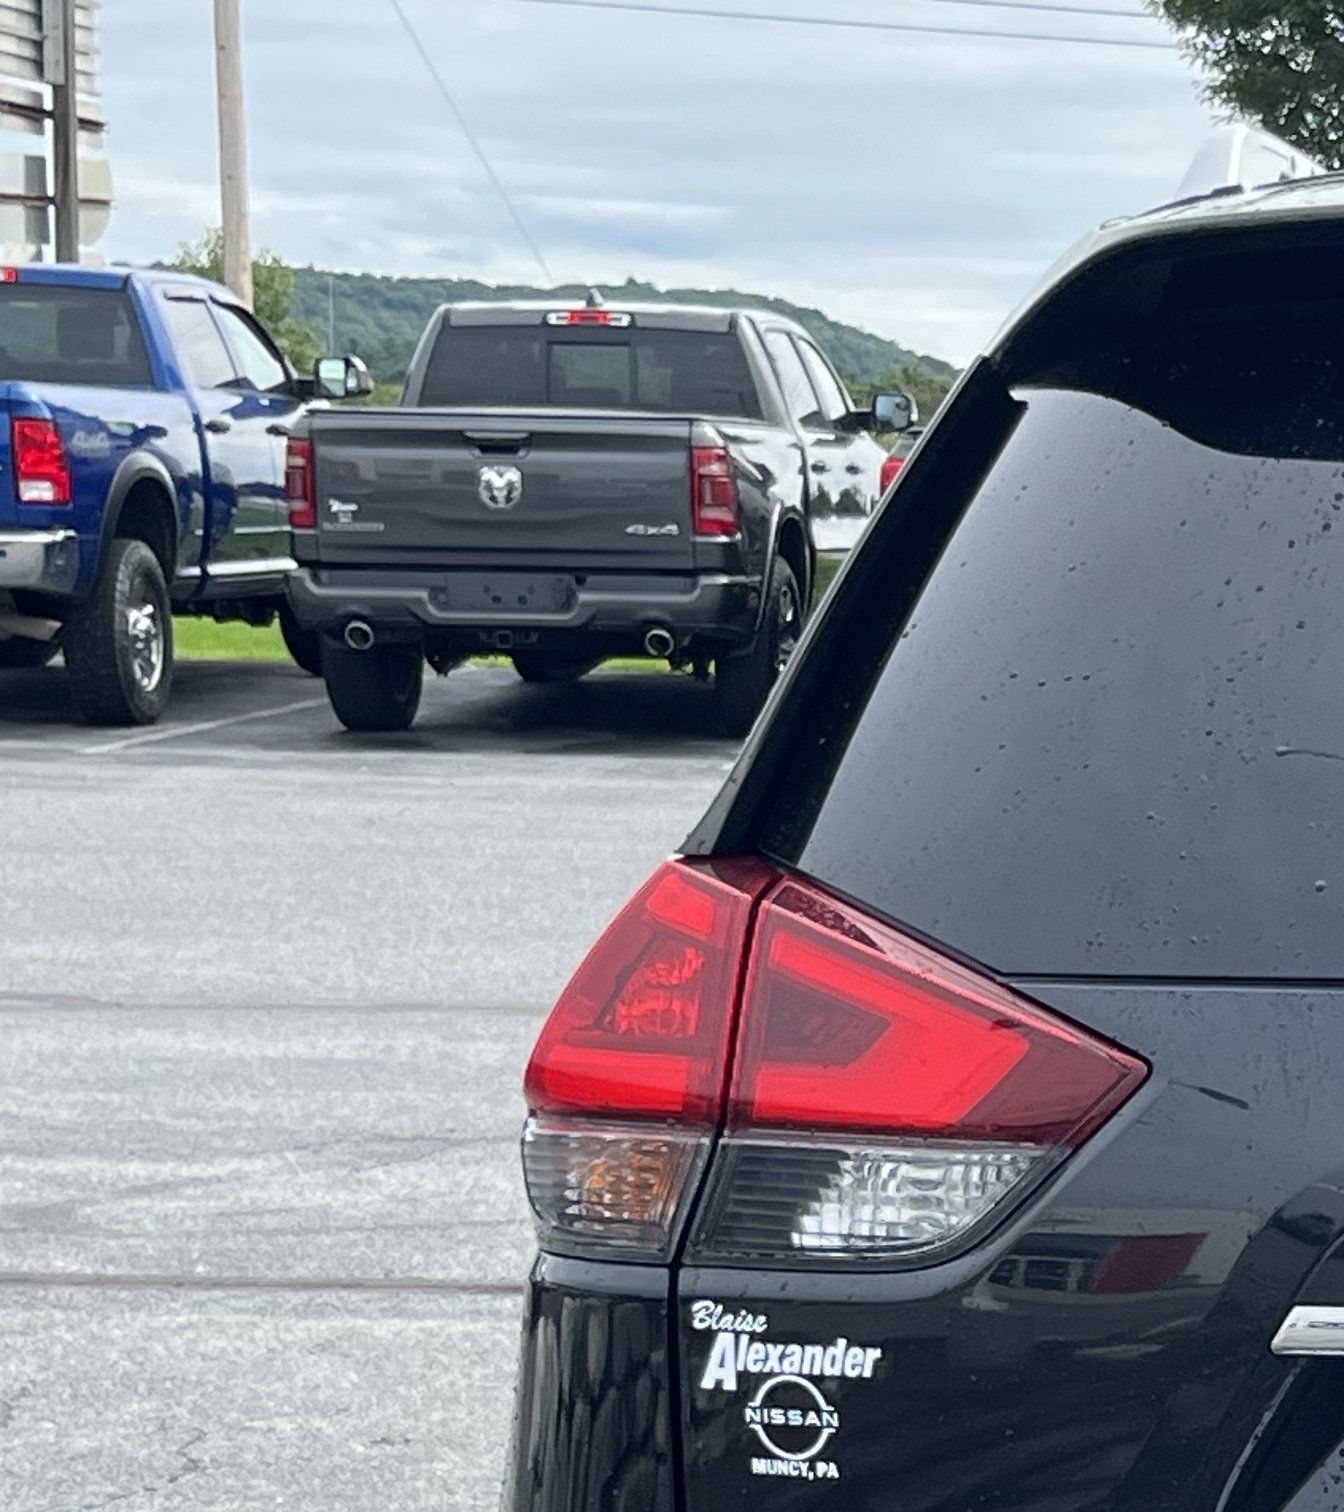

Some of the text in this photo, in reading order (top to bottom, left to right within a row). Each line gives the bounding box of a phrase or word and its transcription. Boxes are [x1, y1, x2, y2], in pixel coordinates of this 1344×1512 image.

[690, 1299, 768, 1333] Blaise
[700, 1331, 882, 1391] Alexander
[744, 1407, 839, 1427] NISSAN
